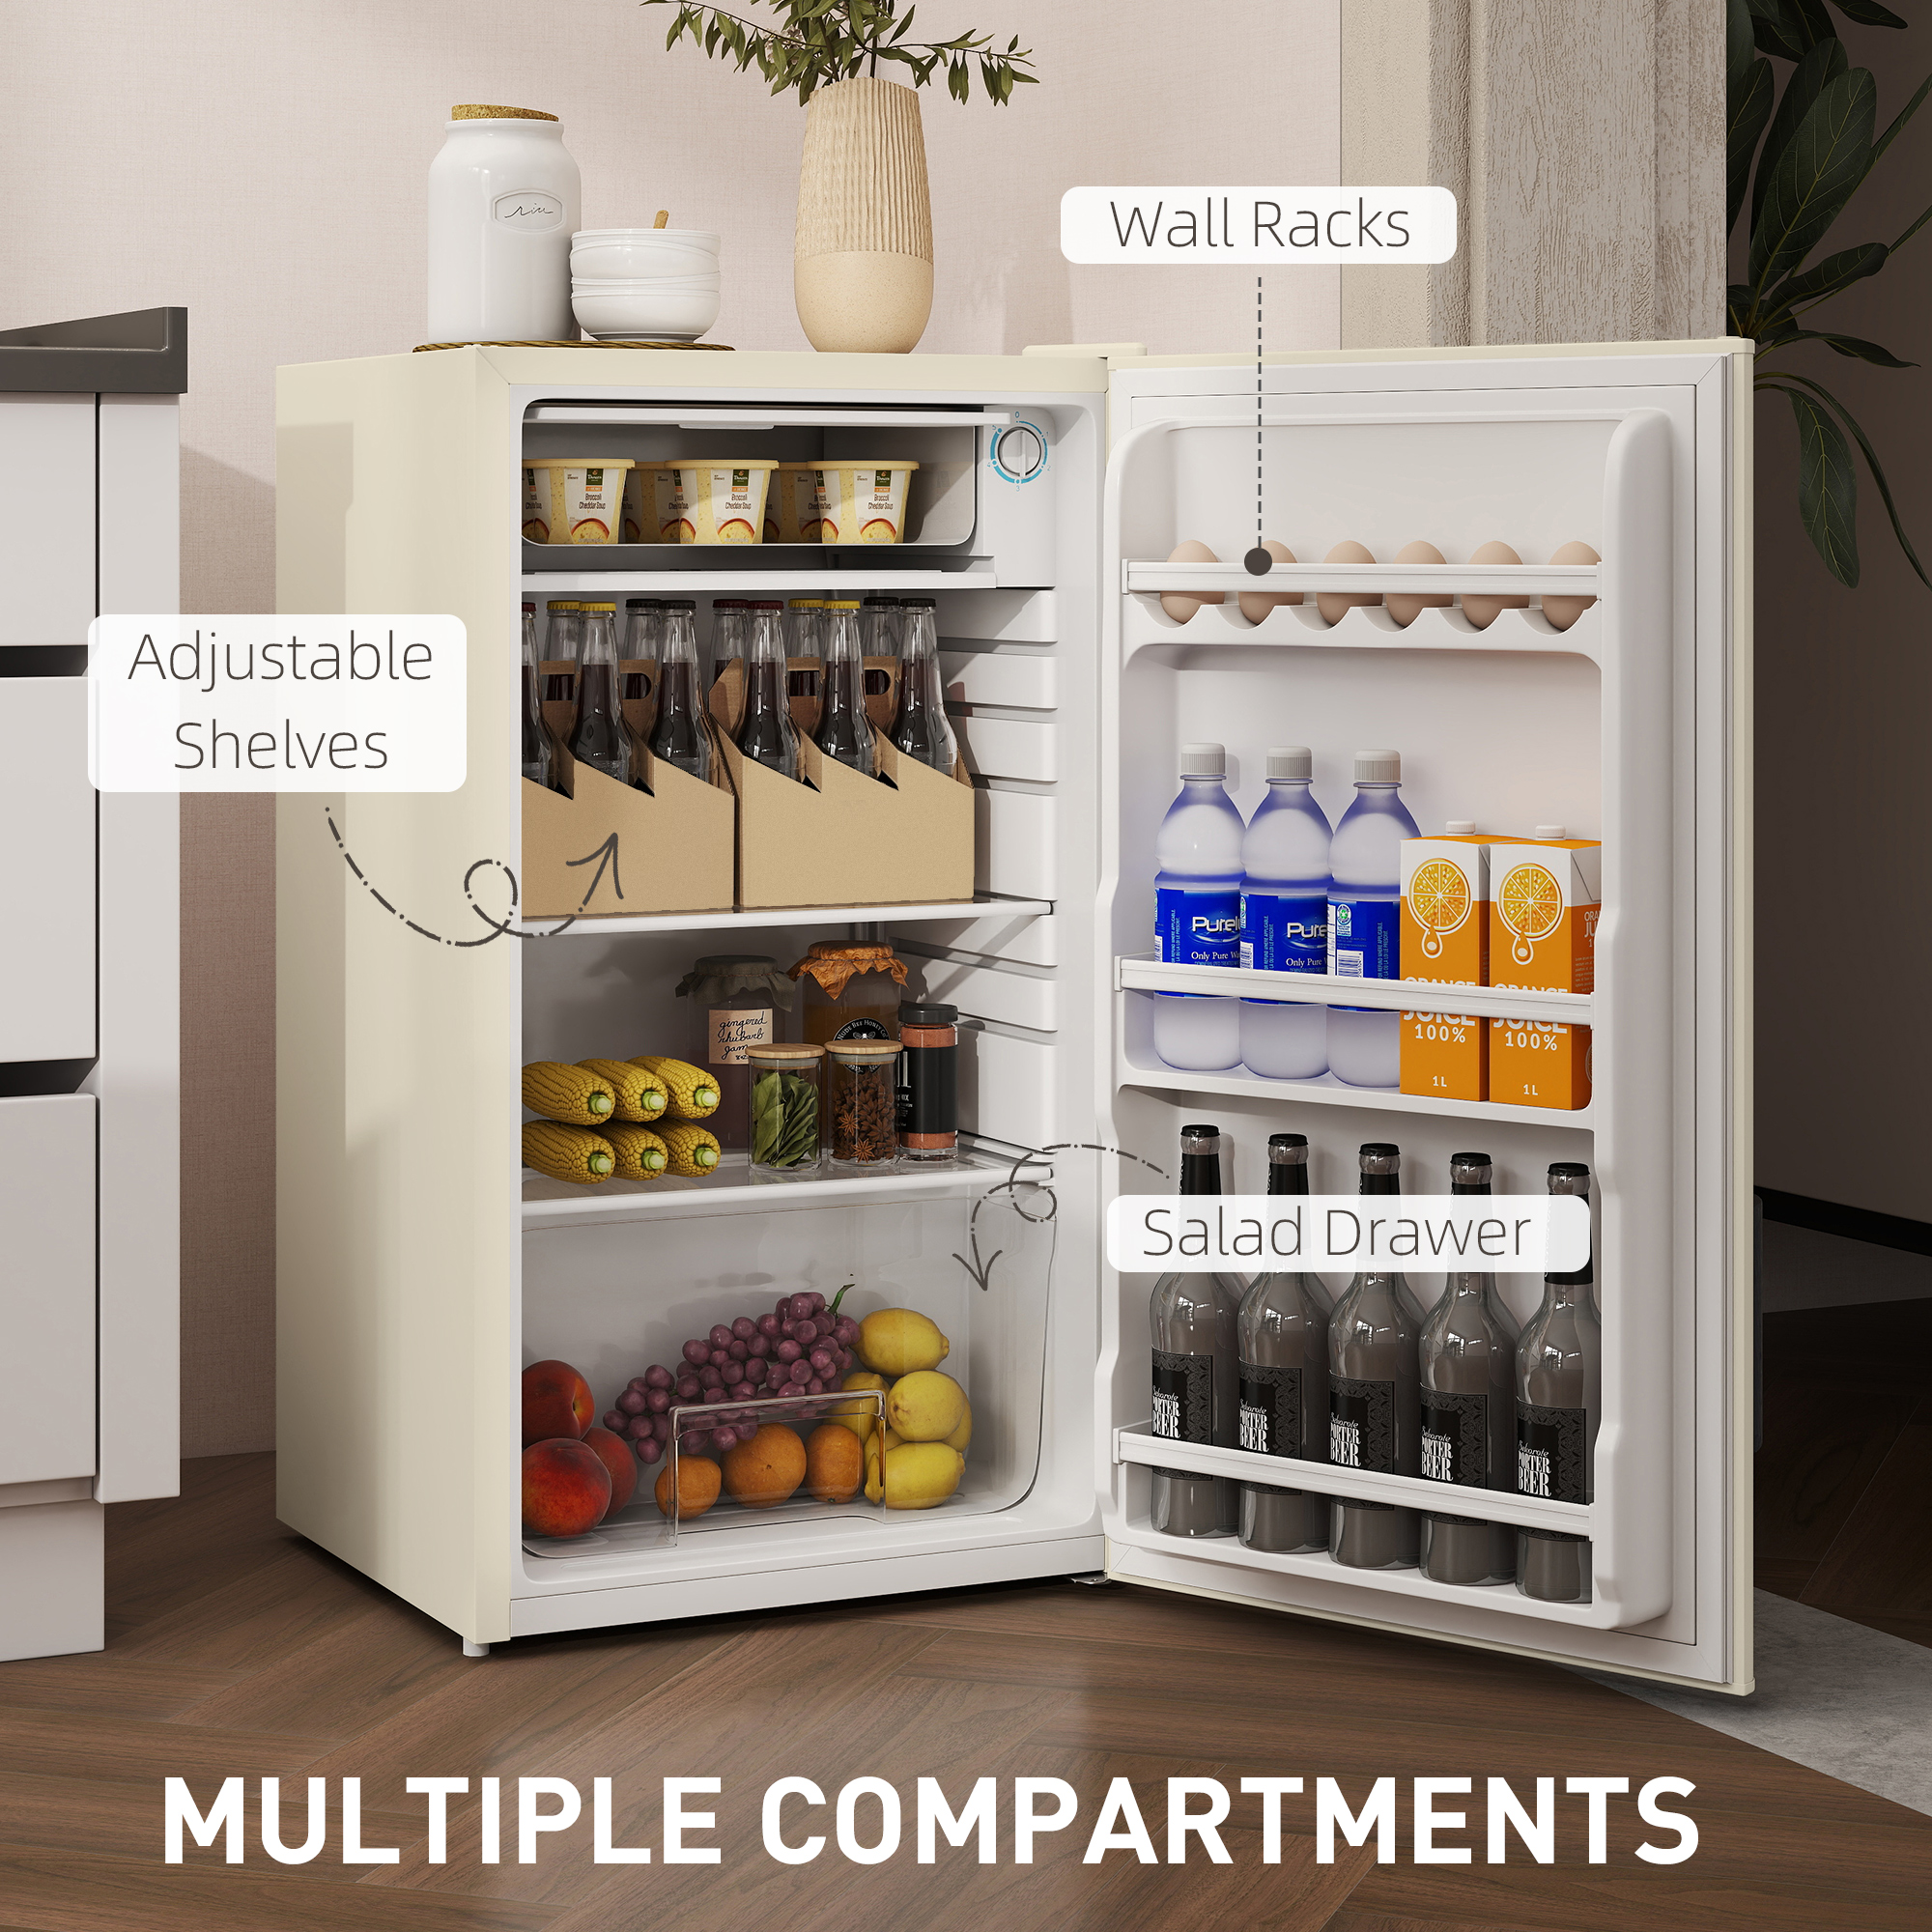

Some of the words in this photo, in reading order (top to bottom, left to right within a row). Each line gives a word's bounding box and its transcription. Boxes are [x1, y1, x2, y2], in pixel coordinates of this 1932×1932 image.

[1192, 916, 1240, 932] Purel
[1191, 951, 1210, 961] Only
[1212, 952, 1228, 960] Pure
[1286, 958, 1305, 968] Only
[1415, 1024, 1466, 1043] 100%
[1505, 1031, 1557, 1051] 100%
[1152, 1410, 1181, 1438] BEER
[1240, 1424, 1269, 1452] BEER
[1331, 1437, 1361, 1467] BEER
[1422, 1452, 1453, 1481] BEER
[1518, 1466, 1552, 1497] BEER
